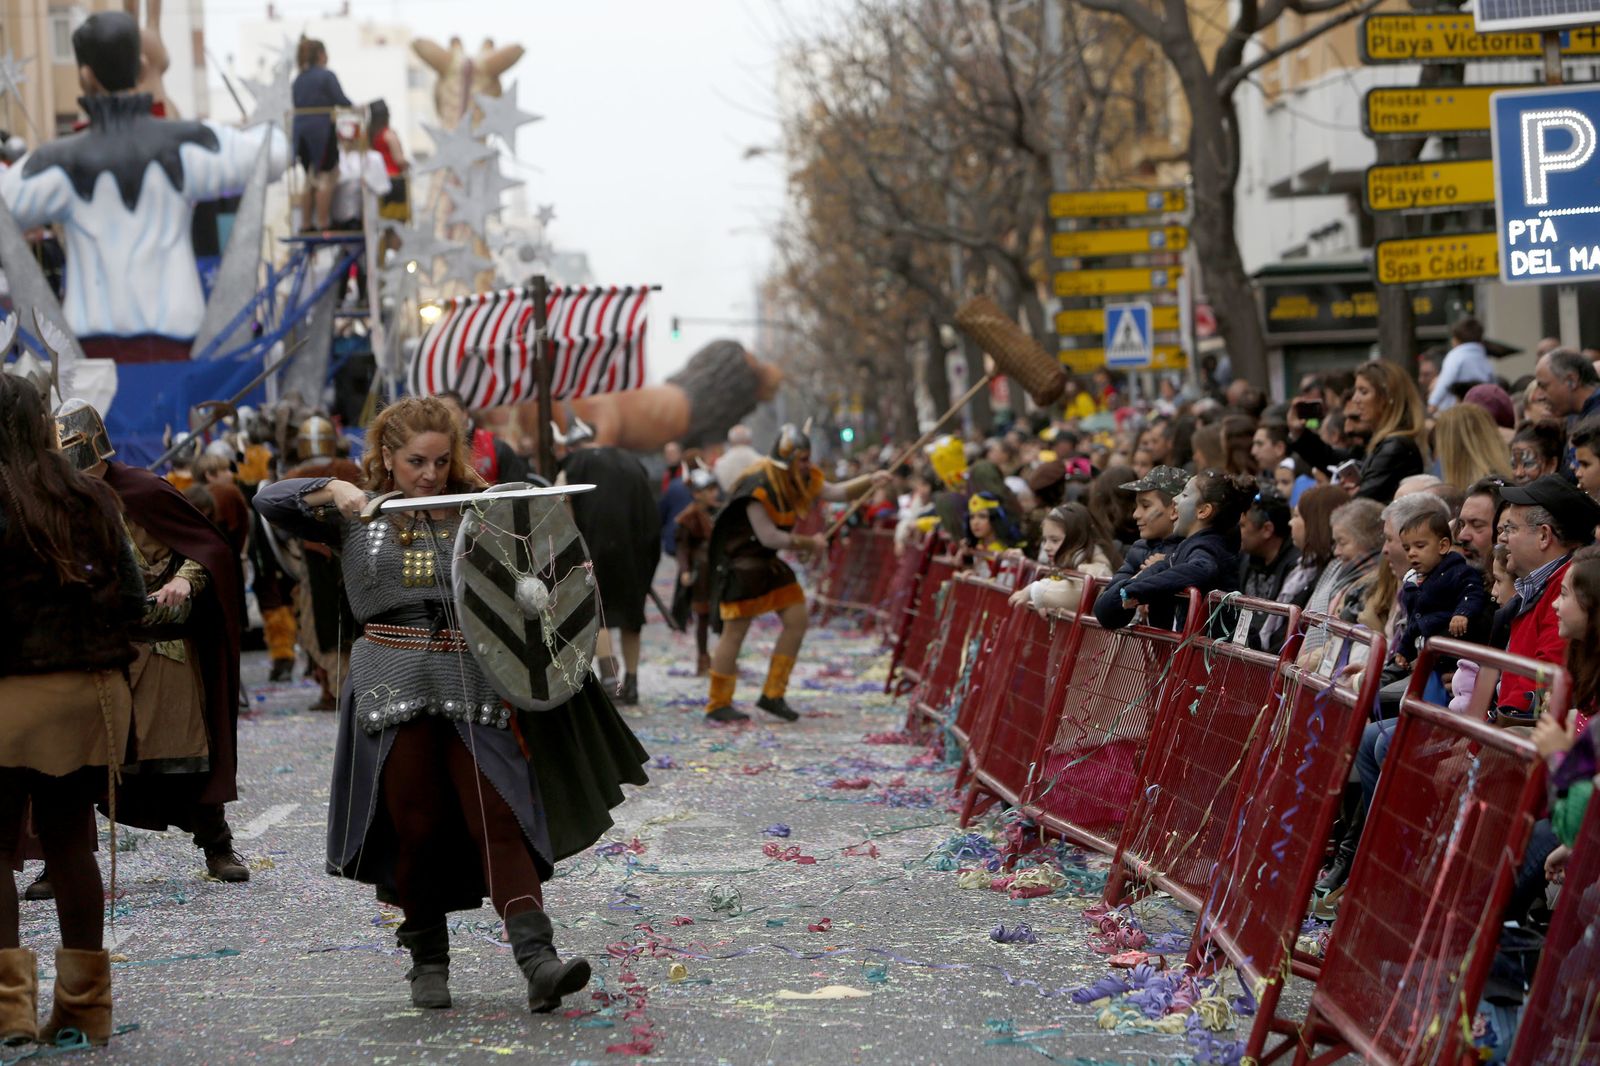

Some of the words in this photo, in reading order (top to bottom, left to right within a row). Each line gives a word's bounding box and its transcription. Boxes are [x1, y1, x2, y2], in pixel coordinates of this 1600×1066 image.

[1372, 34, 1434, 58] Playa
[1443, 31, 1534, 52] Victoria
[1373, 92, 1427, 107] Hostal
[1373, 110, 1420, 126] Imar
[1521, 109, 1597, 206] P
[1372, 170, 1425, 184] Hostal
[1373, 183, 1458, 207] Playero
[1508, 217, 1559, 246] PTA
[1384, 259, 1422, 280] Spa
[1510, 248, 1562, 276] DEL
[1569, 244, 1600, 272] MA
